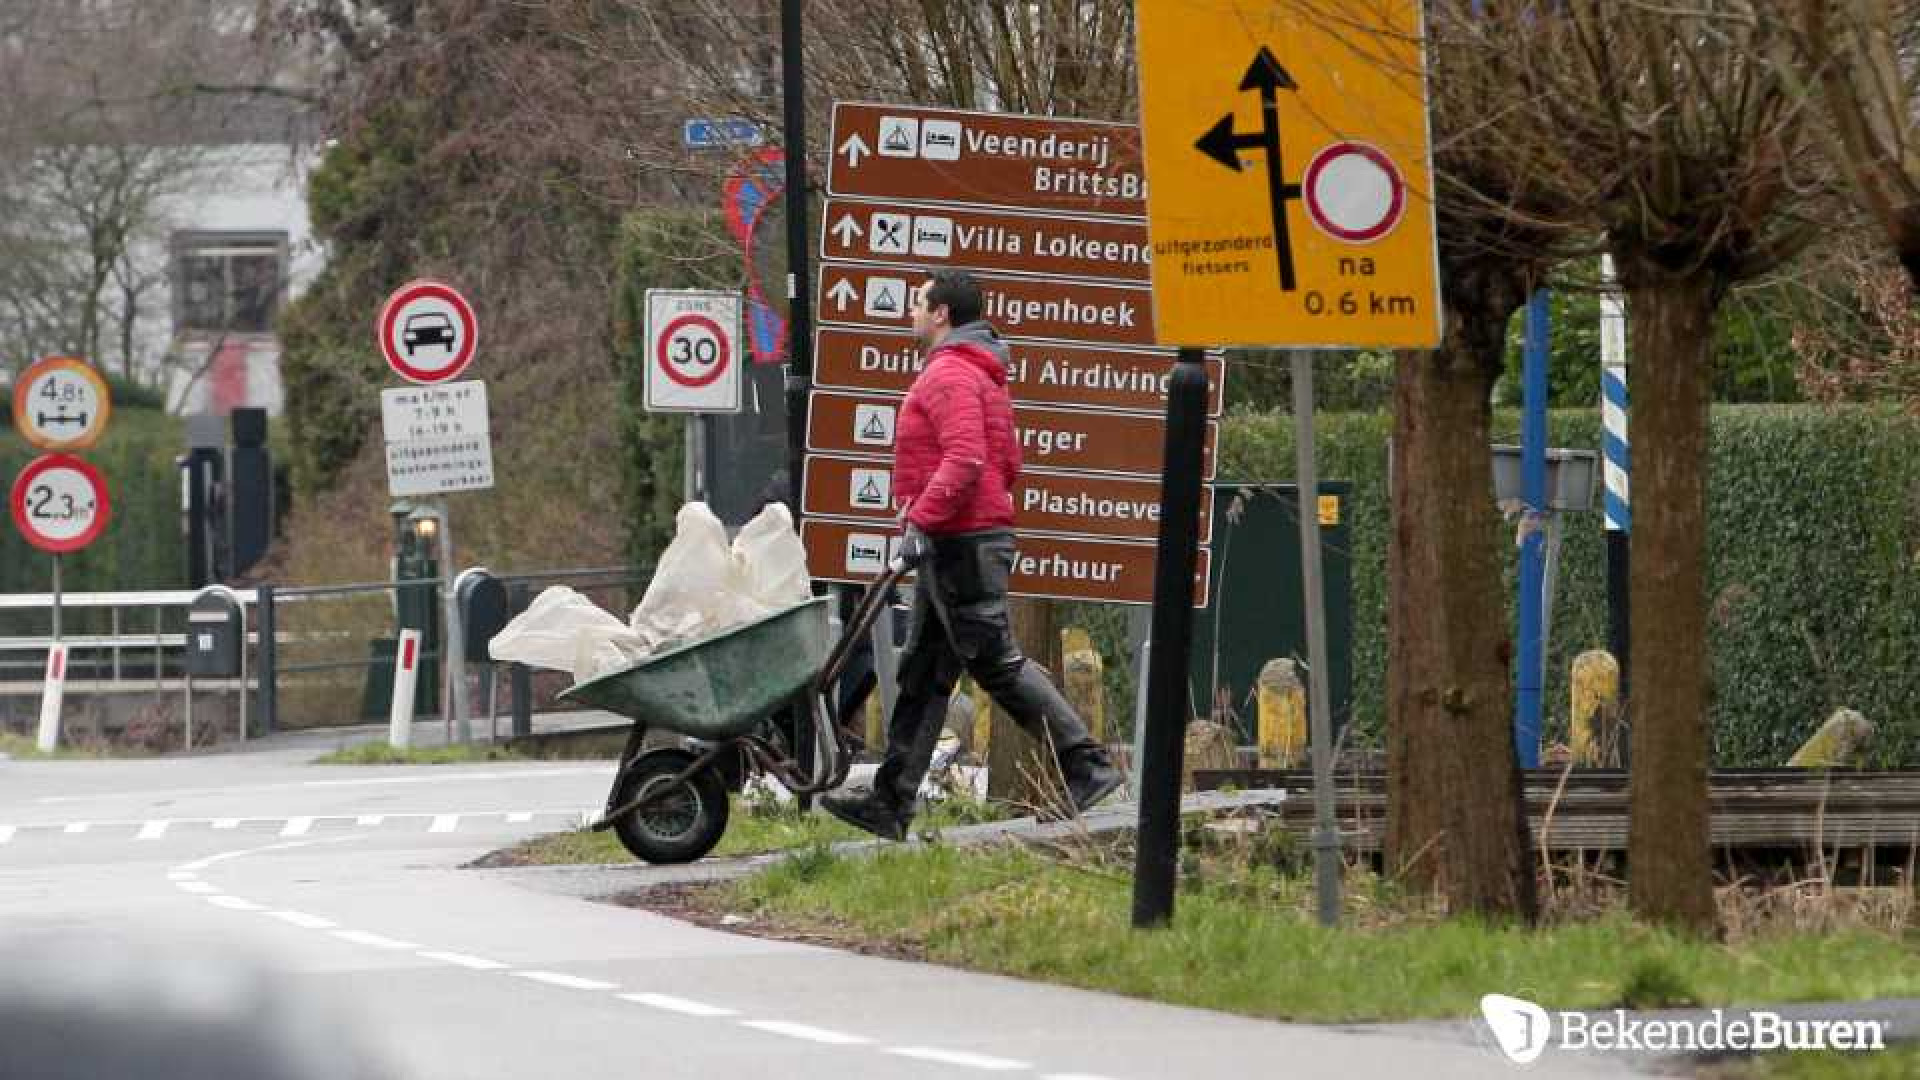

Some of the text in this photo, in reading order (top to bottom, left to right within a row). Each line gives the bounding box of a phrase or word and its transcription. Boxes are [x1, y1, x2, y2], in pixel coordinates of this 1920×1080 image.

[966, 129, 1109, 168] Veenderij
[956, 225, 1022, 254] Villa
[1155, 233, 1273, 256] uitgezonderd
[1184, 259, 1249, 276] fietsers
[1339, 257, 1376, 276] na
[985, 290, 1136, 328] ilgenhoek
[1304, 291, 1416, 316] 0.6 km
[671, 337, 717, 366] 30
